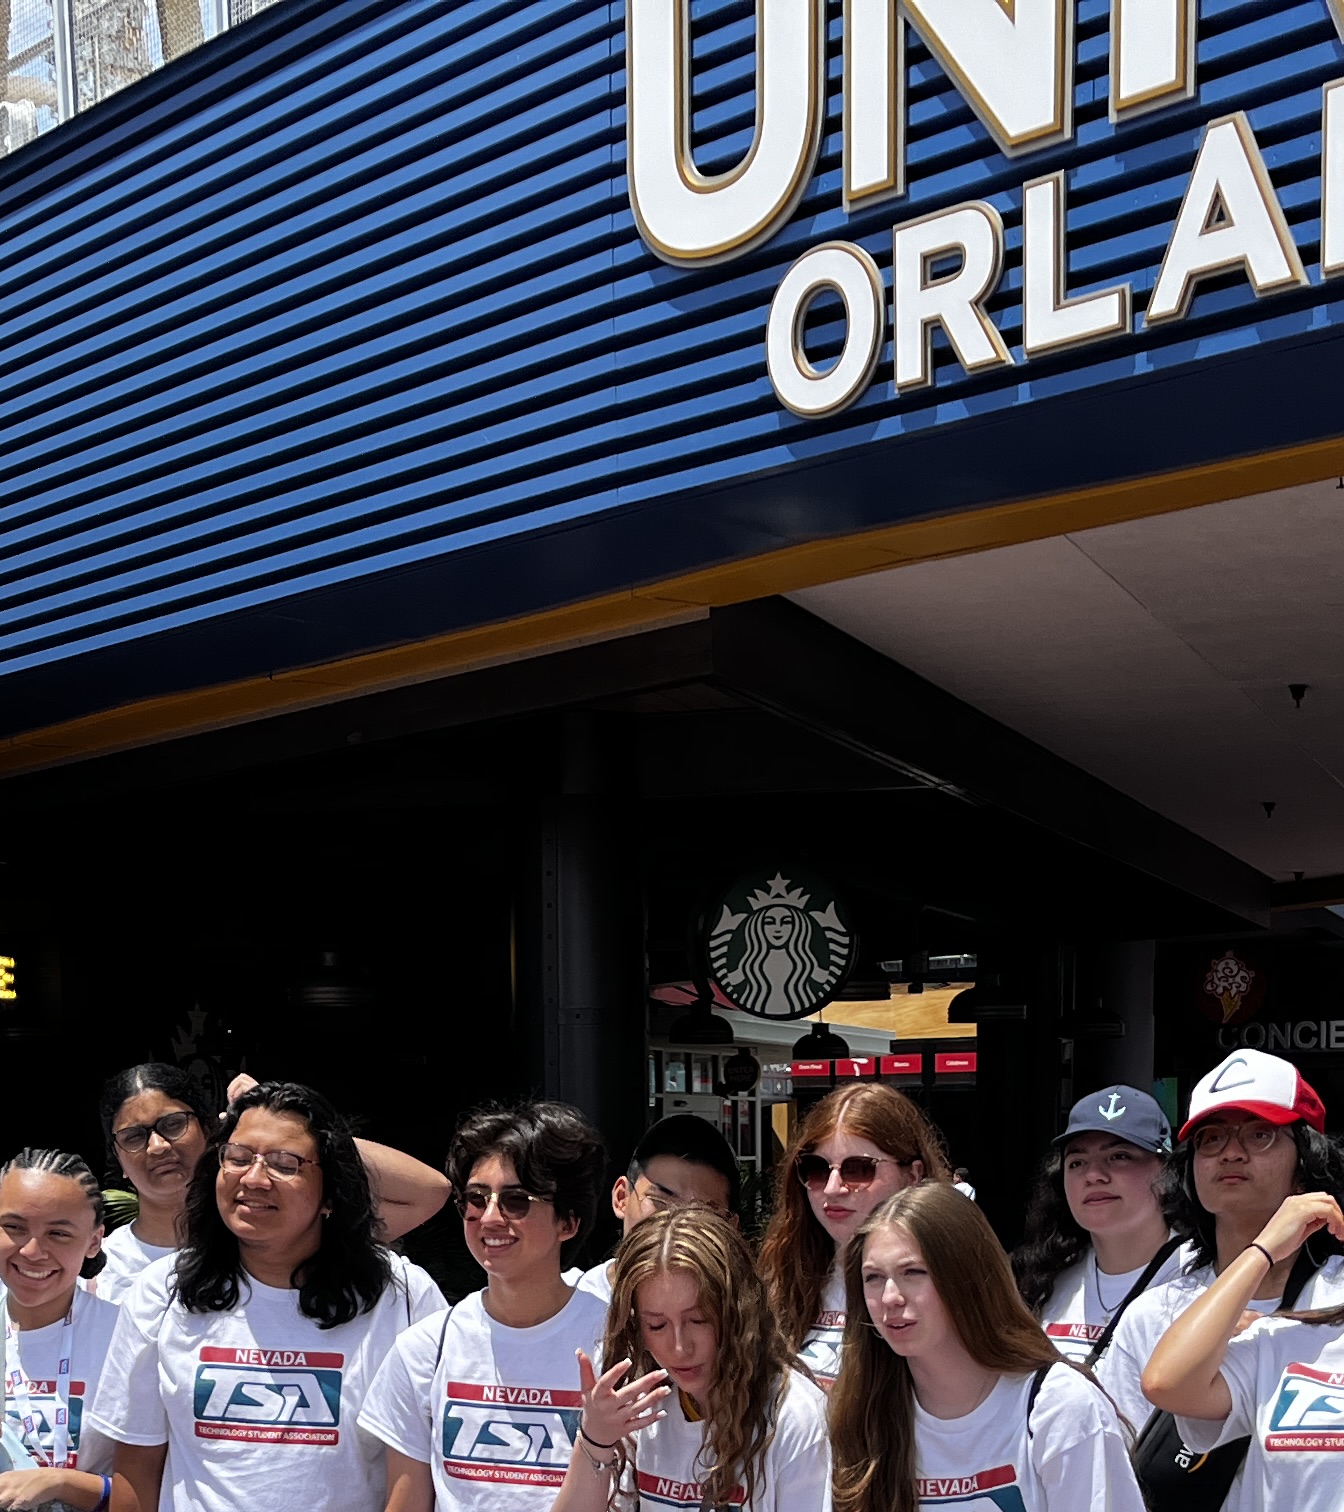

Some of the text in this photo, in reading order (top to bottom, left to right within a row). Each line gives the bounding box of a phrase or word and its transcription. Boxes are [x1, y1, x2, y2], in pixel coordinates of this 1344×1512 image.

[1068, 1324, 1106, 1340] NEVA
[235, 1349, 307, 1366] NEVADA
[199, 1367, 335, 1423] TSA
[482, 1386, 553, 1405] NEVADA
[198, 1425, 335, 1441] TECHNOLOGY STUDENT ASSOCIATION
[447, 1404, 574, 1464] TSA
[1269, 1437, 1324, 1447] TECHNOLOGY
[446, 1464, 494, 1478] TECHNOLOGY
[494, 1470, 529, 1481] STUDENT
[915, 1475, 979, 1496] NEVADA
